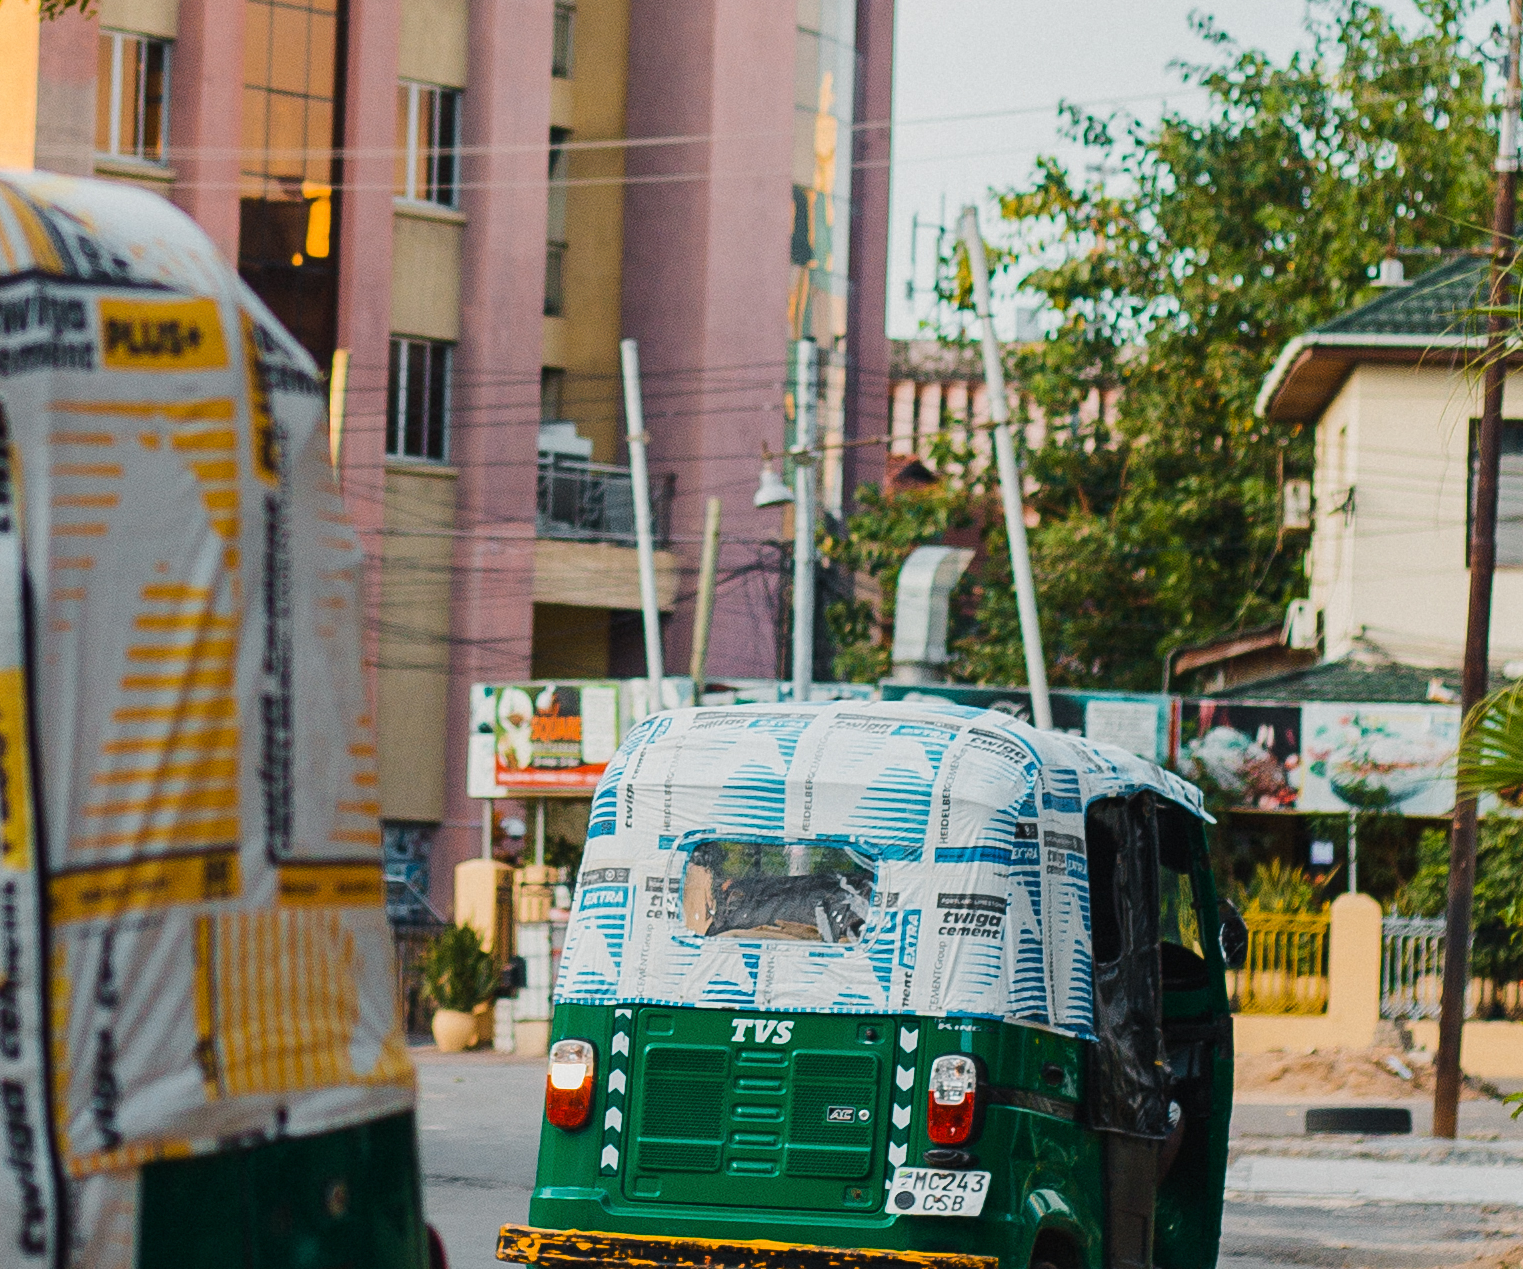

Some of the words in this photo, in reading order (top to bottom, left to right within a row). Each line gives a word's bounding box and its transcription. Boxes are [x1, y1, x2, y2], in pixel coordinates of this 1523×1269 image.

[584, 890, 624, 906] EXTRA
[942, 911, 1003, 928] twiga
[938, 926, 1001, 940] cement
[731, 1018, 795, 1044] TVS
[912, 1171, 986, 1193] MC243
[922, 1194, 965, 1212] CSB
